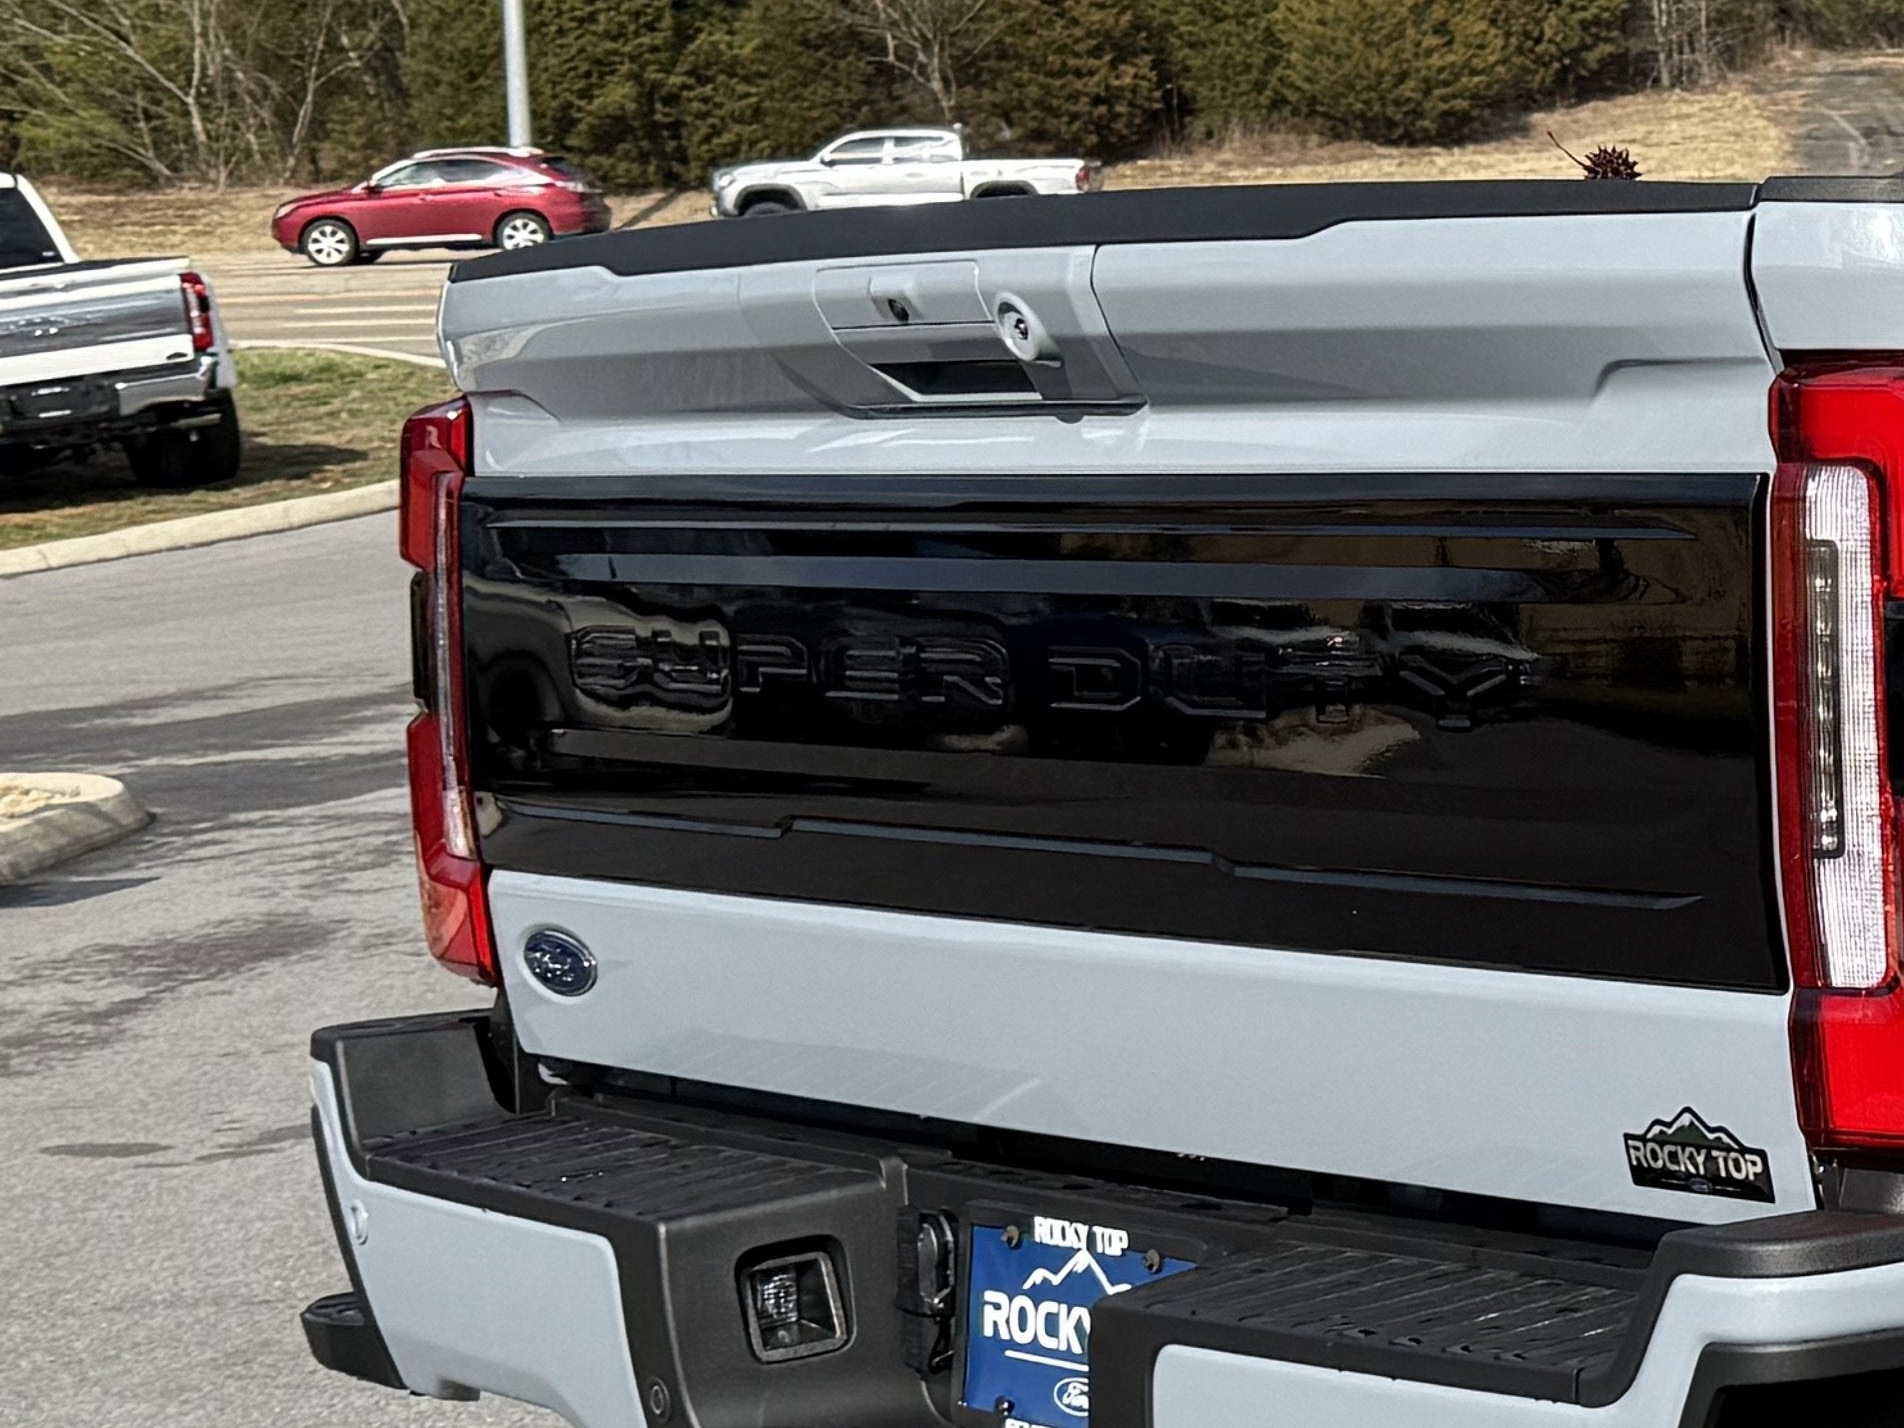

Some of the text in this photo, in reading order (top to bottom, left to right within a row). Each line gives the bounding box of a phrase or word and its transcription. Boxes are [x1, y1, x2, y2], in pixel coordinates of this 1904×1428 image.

[570, 624, 1535, 732] SUPER DUTY
[1627, 1139, 1764, 1181] ROCKY TOP
[1033, 1216, 1129, 1257] ROCKY TOP
